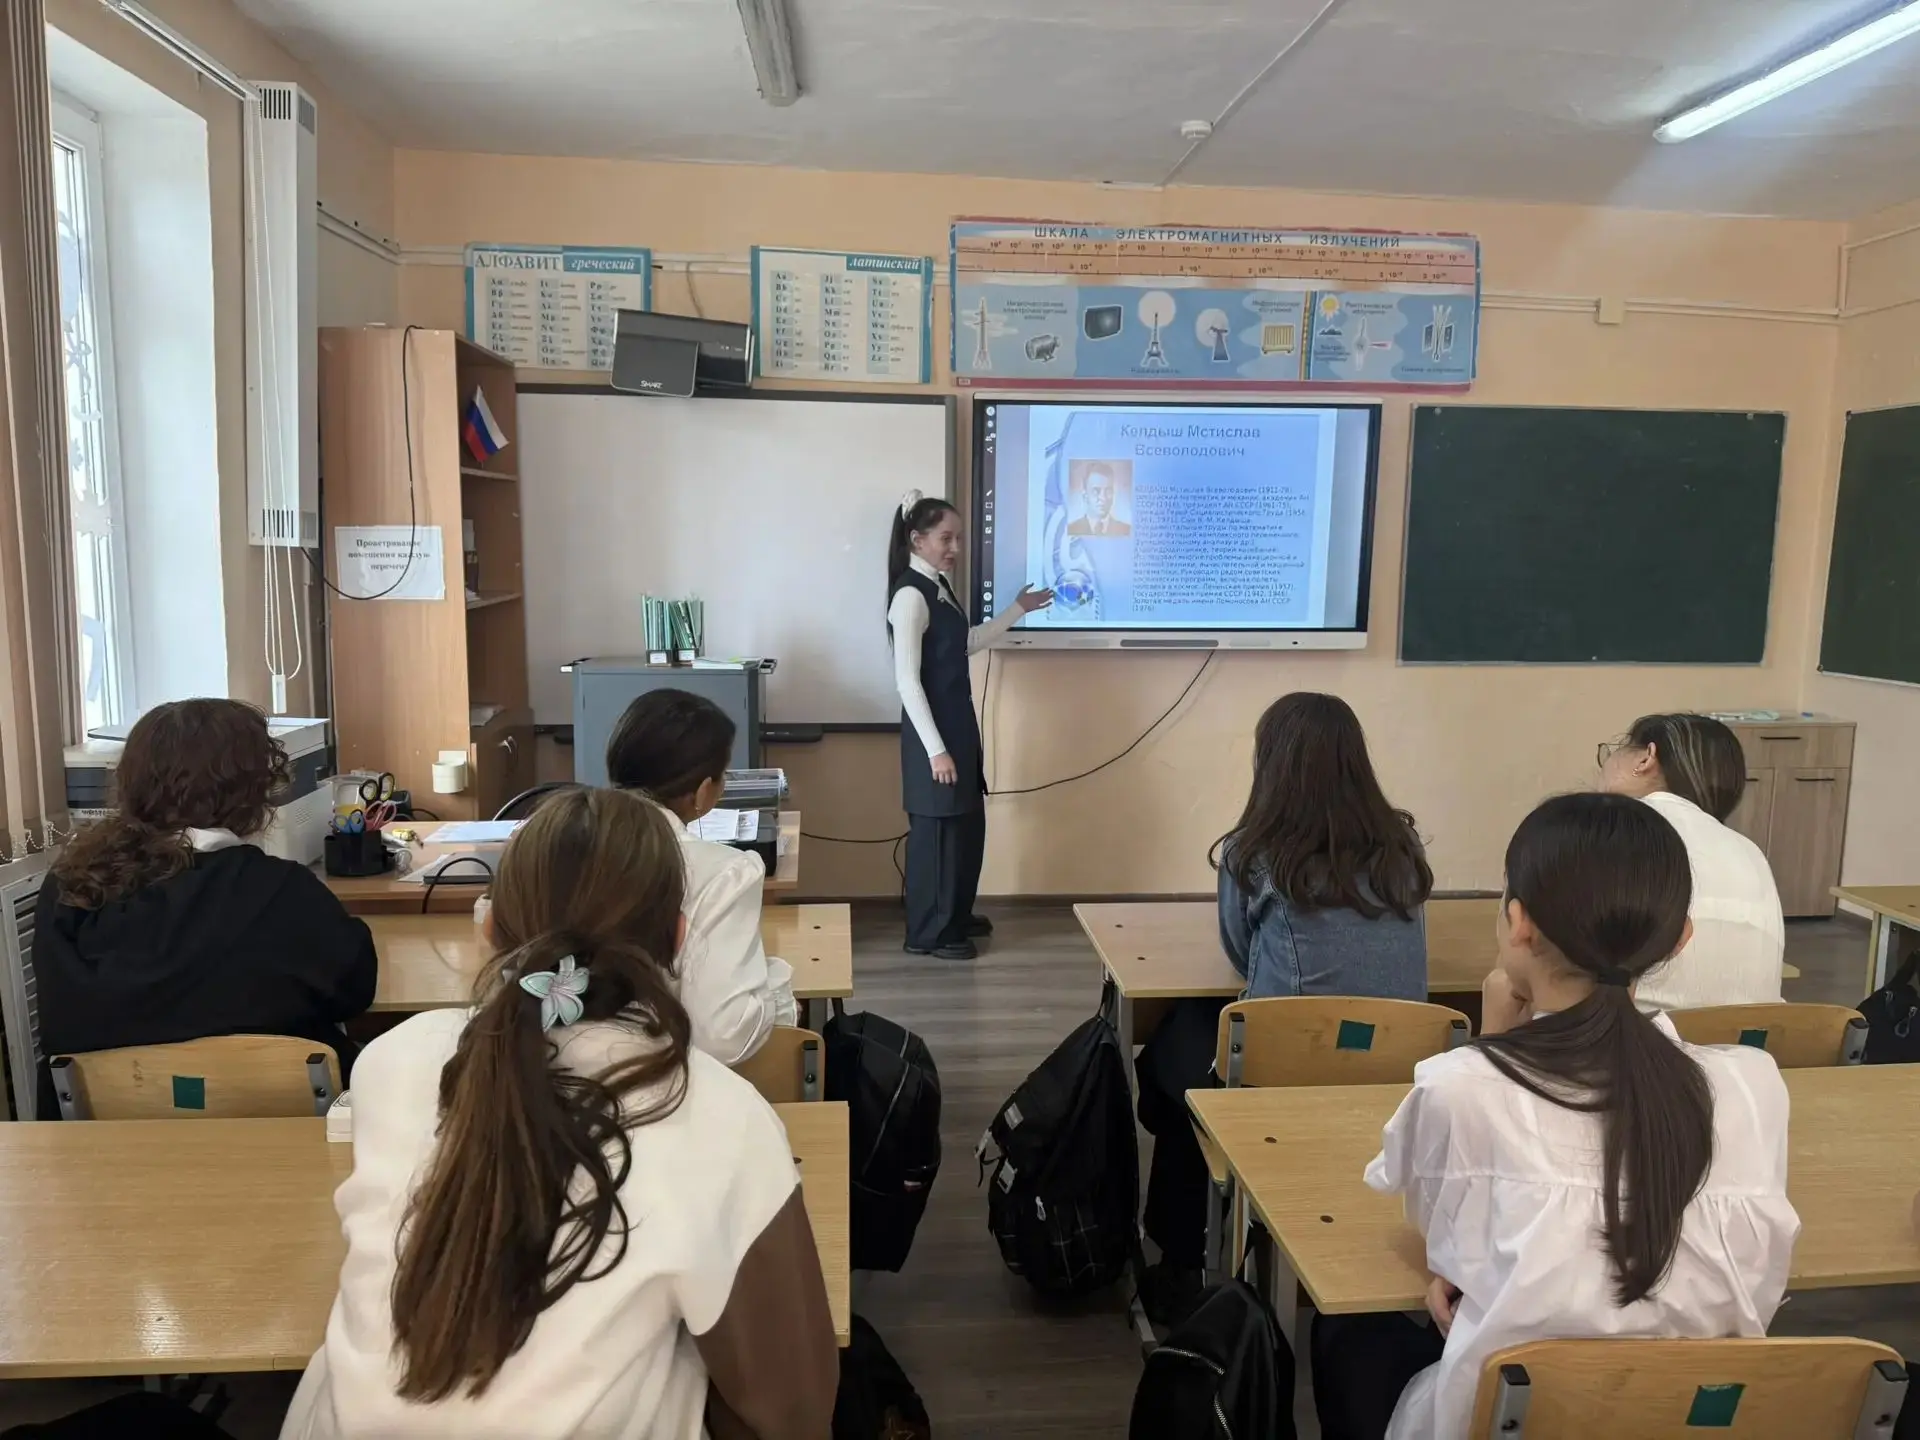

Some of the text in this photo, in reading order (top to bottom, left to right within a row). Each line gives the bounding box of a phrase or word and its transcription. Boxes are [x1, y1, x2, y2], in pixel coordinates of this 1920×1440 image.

[1034, 227, 1400, 248] ШКАЛА ЭЛЕКТРОМАГНИТНЫХ ИЗЛУЧЕНИЙ
[474, 254, 635, 271] АЛФАВИТ греческий
[849, 256, 920, 271] латинский
[640, 380, 663, 389] SMART
[1120, 424, 1261, 439] Келдыш Мстислав
[1135, 443, 1245, 458] Всеволодович
